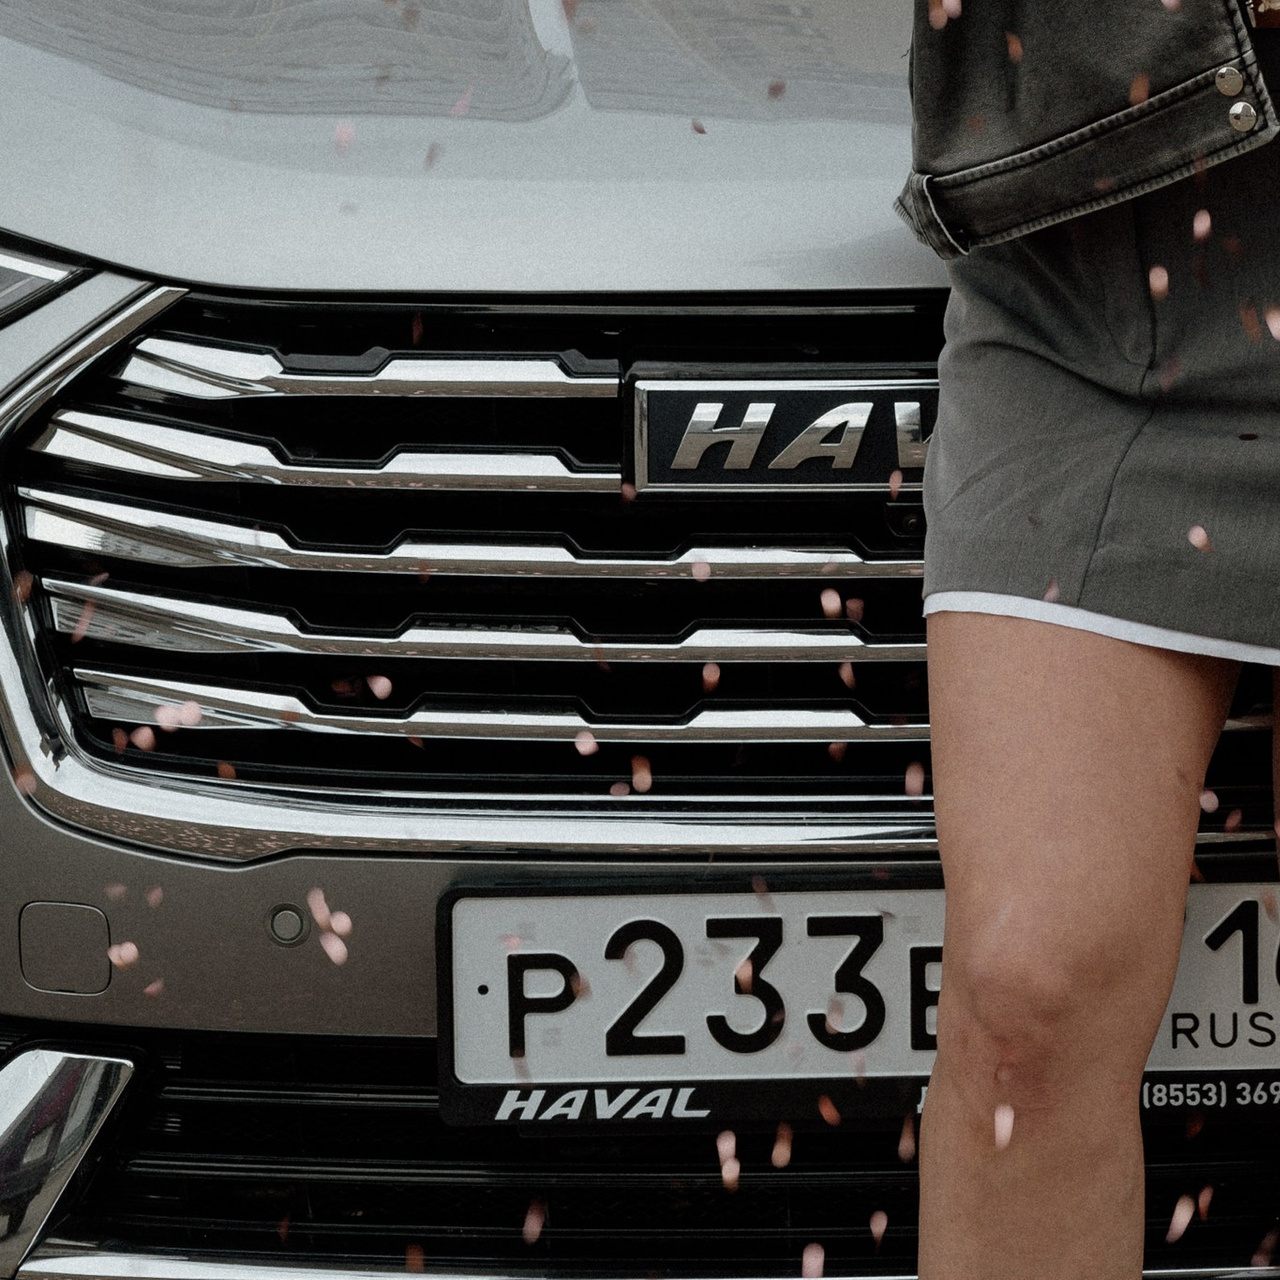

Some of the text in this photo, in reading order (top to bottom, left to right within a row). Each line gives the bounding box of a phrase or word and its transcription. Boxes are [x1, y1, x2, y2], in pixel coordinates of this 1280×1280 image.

[1171, 1011, 1277, 1050] RUS
[494, 1087, 711, 1121] HAVAL
[1142, 1080, 1228, 1110] (8553)
